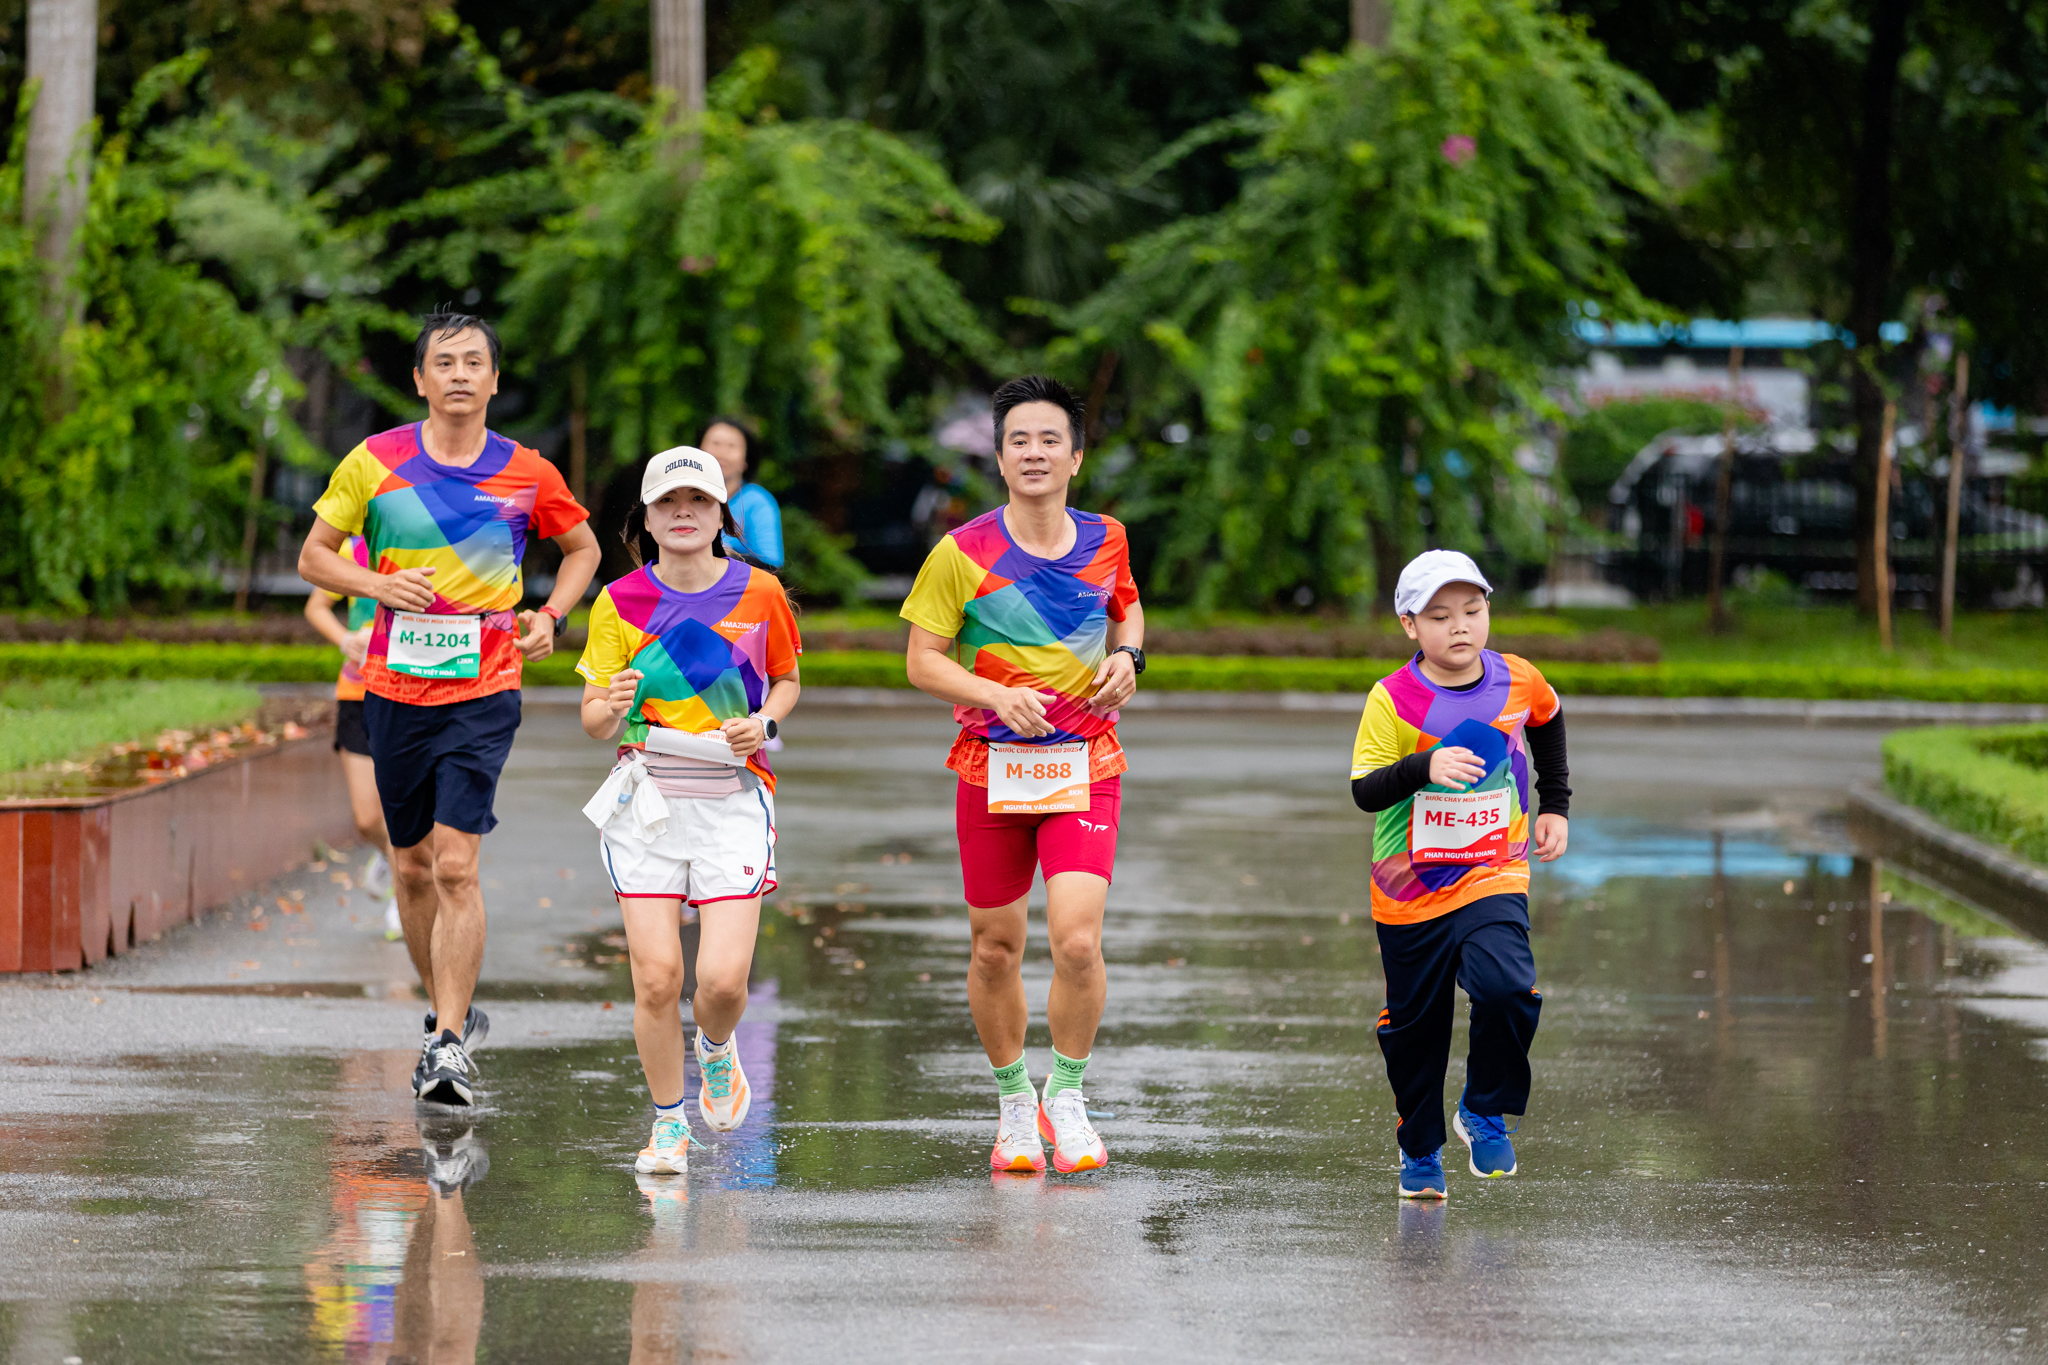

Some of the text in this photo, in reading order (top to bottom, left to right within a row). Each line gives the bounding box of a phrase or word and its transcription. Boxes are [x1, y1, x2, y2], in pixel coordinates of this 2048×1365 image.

[664, 458, 704, 474] COLORADO
[474, 495, 507, 504] AMAZING
[720, 620, 755, 630] AMAZING
[399, 629, 471, 648] M-1204
[1006, 762, 1072, 780] M-888
[1489, 792, 1503, 800] 2025
[1424, 807, 1500, 828] ME-435
[1489, 833, 1503, 841] 4KM
[1424, 851, 1443, 859] PHAN
[1474, 848, 1497, 858] KHANG
